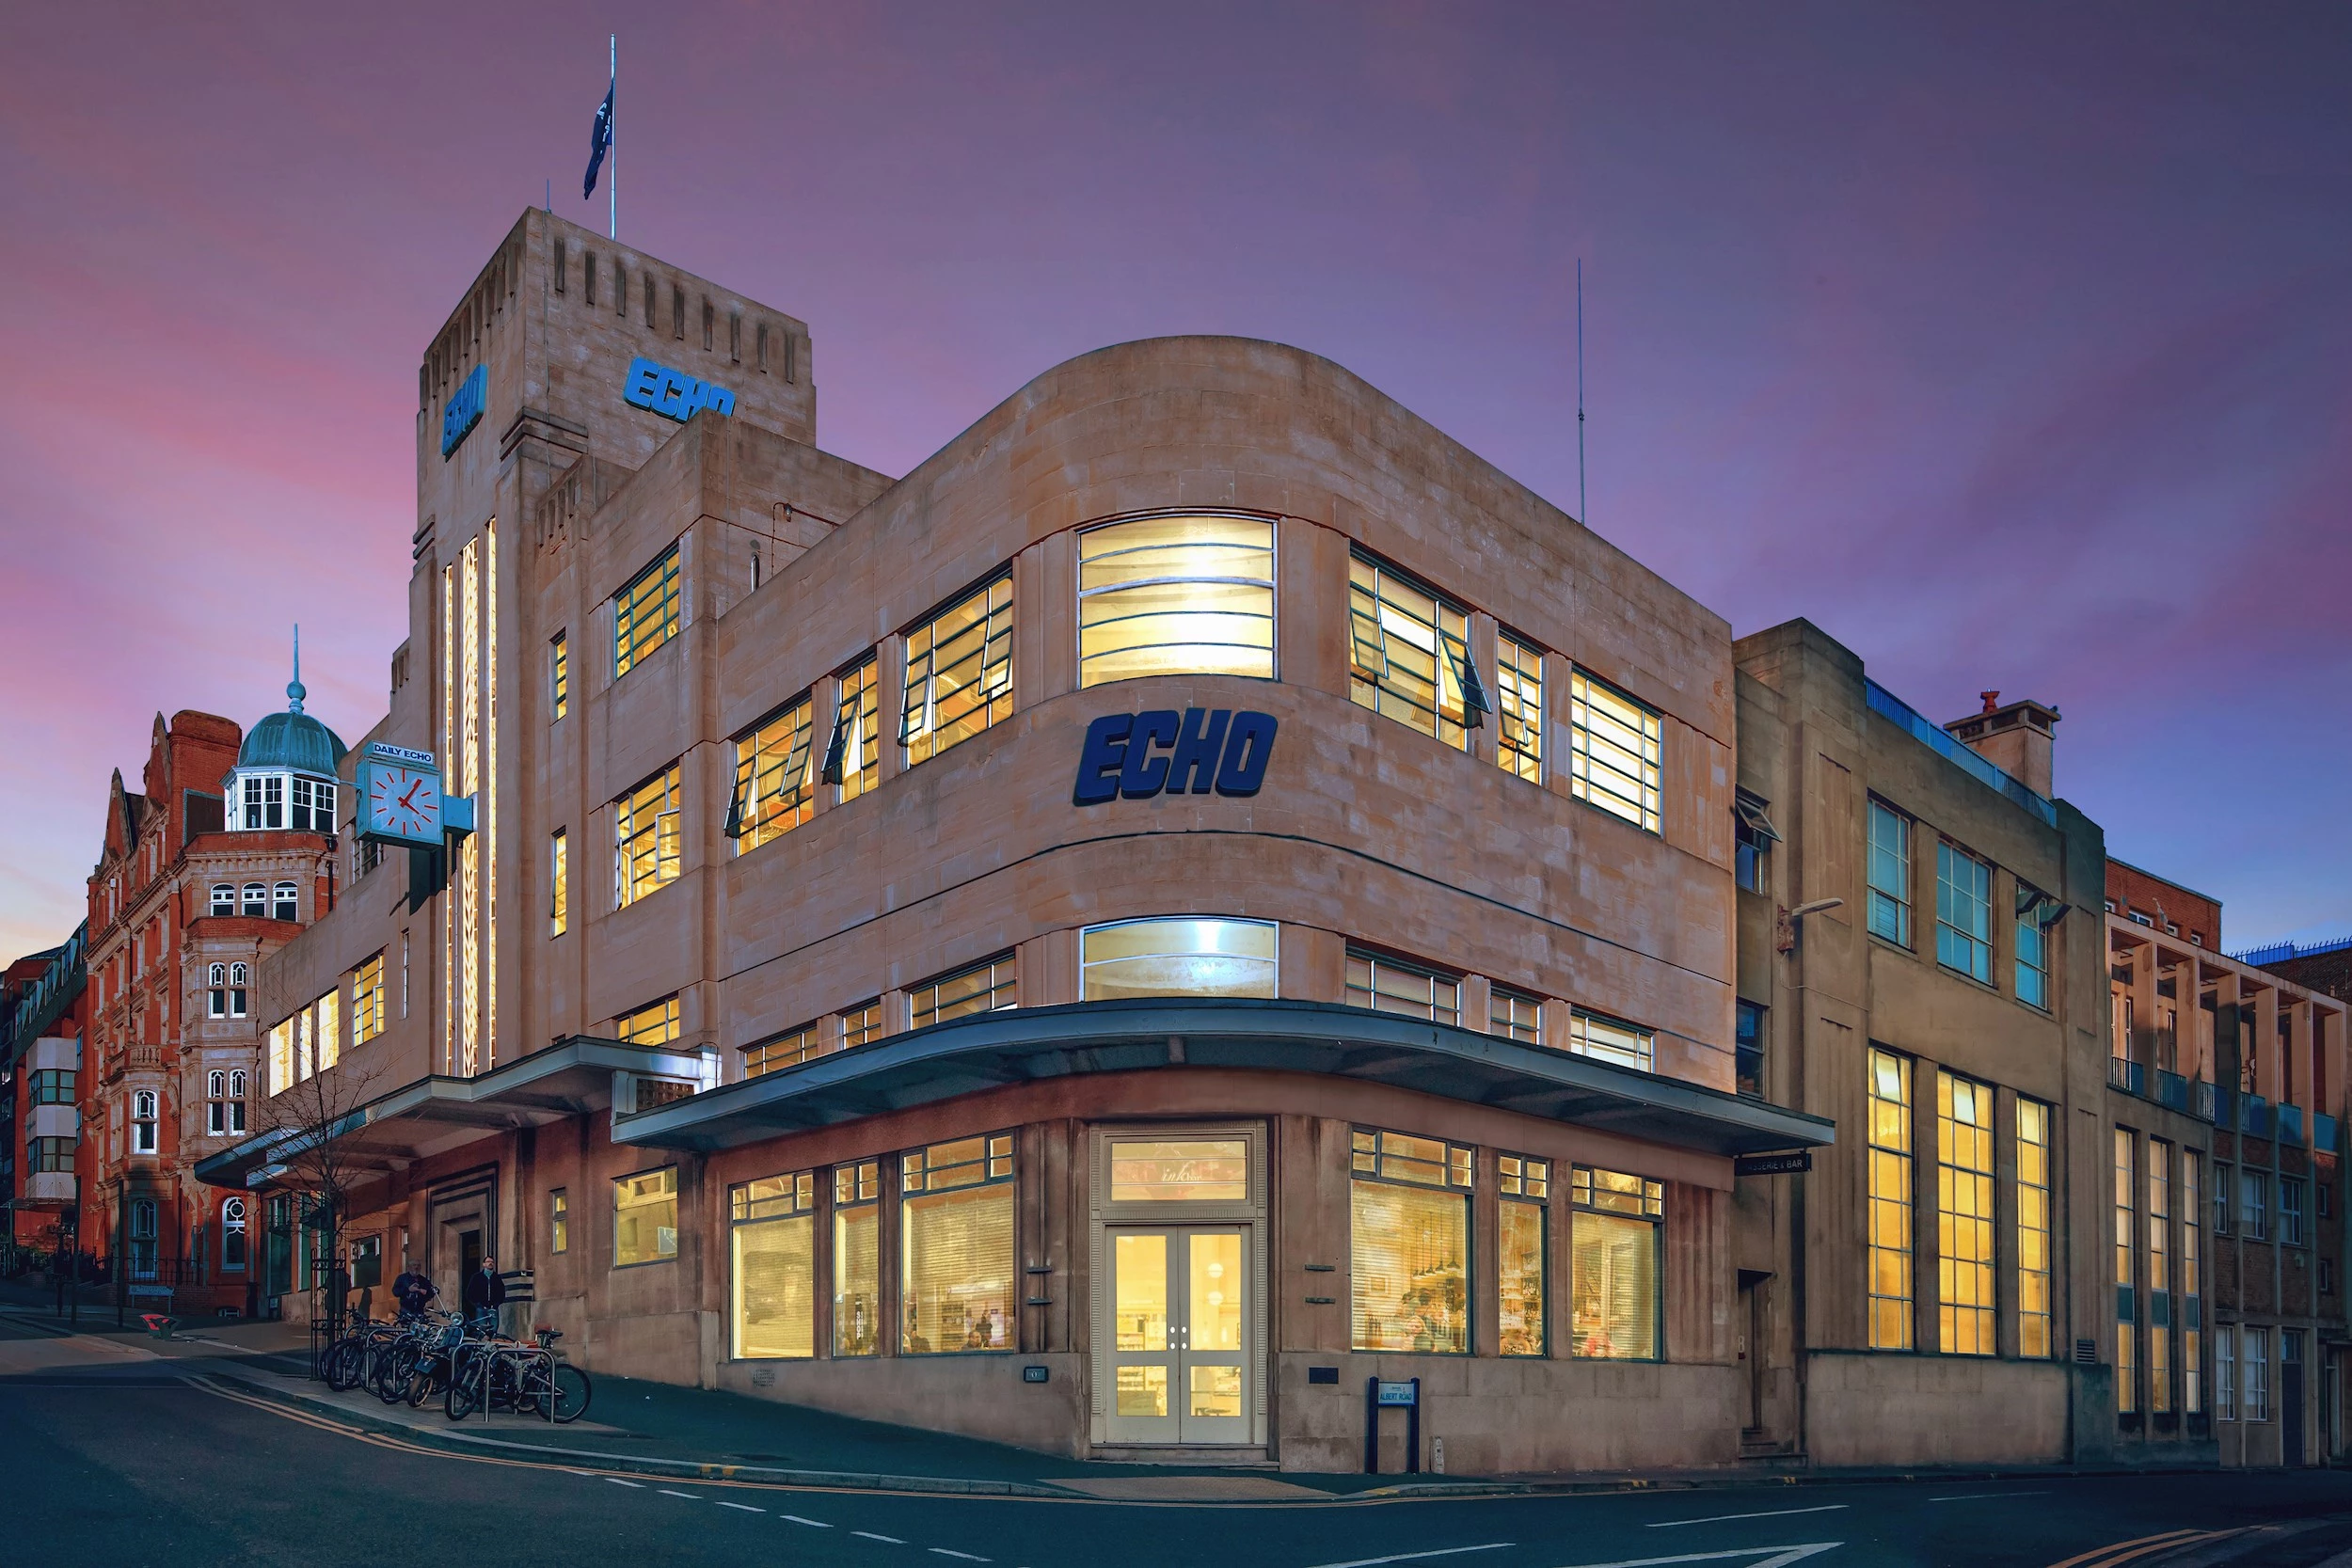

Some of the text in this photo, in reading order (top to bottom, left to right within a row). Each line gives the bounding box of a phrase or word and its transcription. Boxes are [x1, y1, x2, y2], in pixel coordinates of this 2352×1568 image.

[624, 356, 736, 424] ECHO
[374, 744, 432, 763] DAILY ECHO
[1073, 707, 1279, 807] ECHO
[1787, 1159, 1803, 1169] BAR
[1380, 1392, 1412, 1401] ALBERT ROAD
